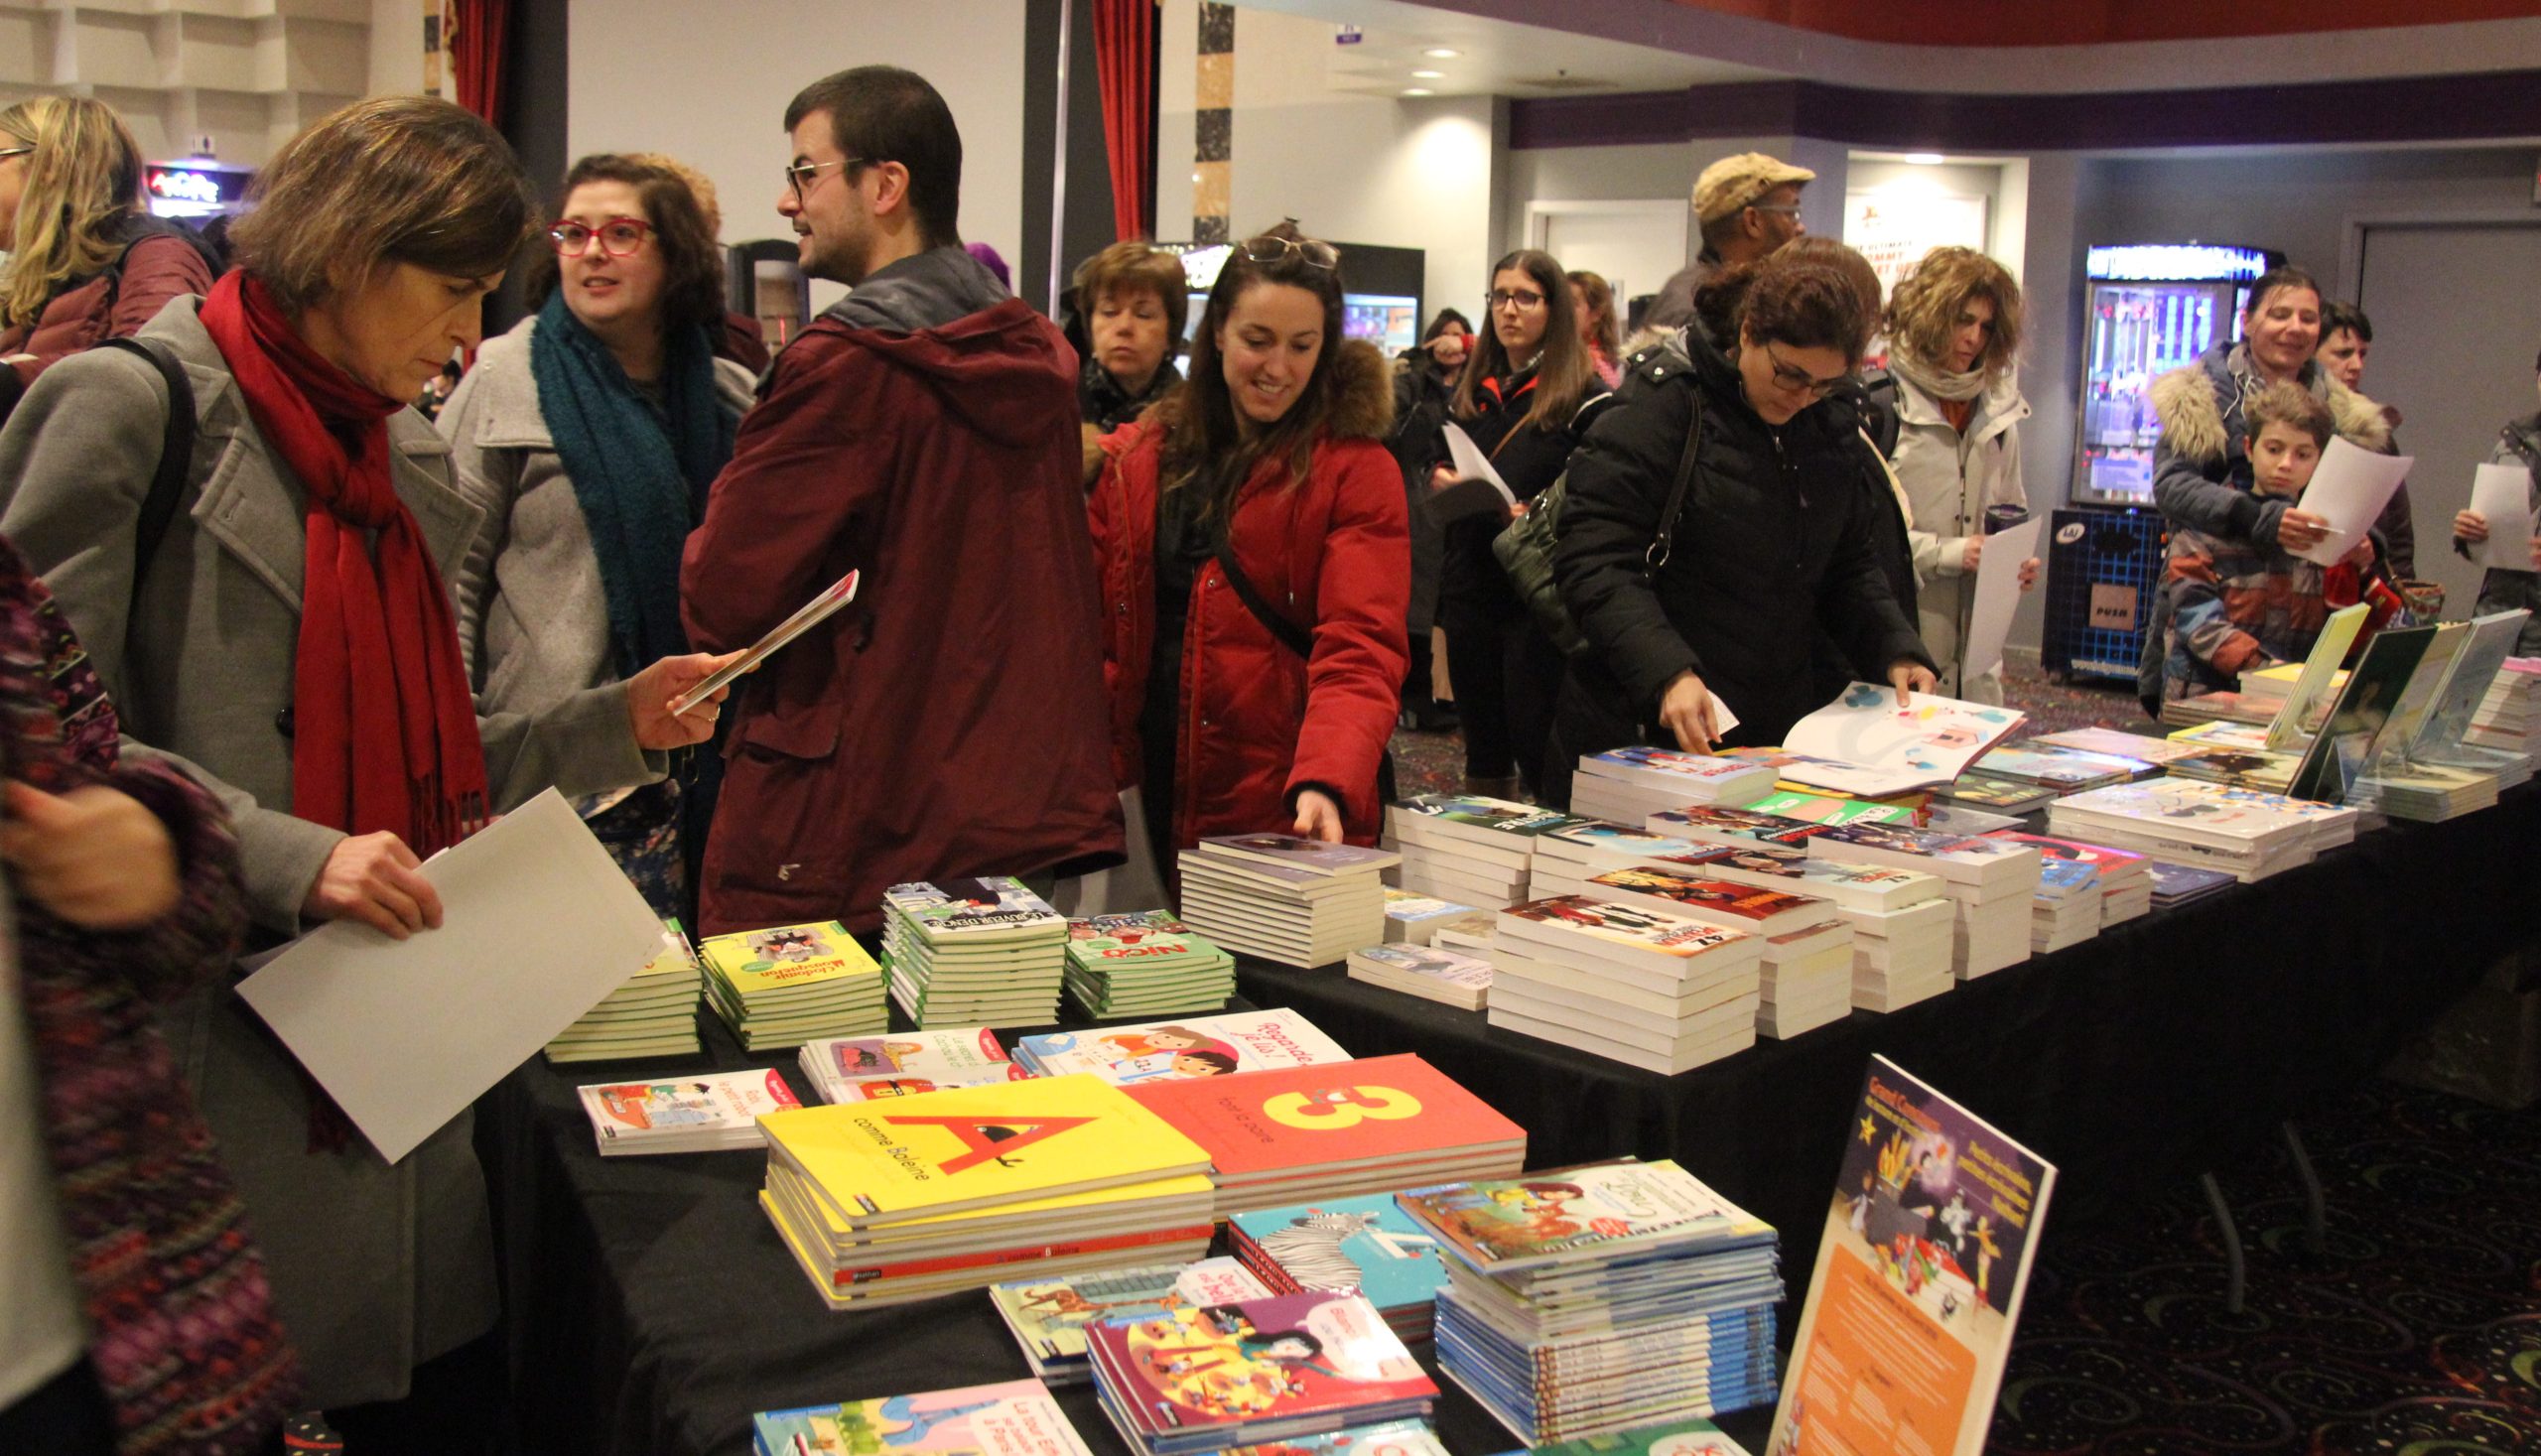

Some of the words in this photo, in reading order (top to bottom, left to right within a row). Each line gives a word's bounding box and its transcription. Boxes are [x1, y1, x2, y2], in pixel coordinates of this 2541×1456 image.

[1263, 1085, 1422, 1130] 3
[853, 1117, 893, 1149] comme
[886, 1146, 930, 1182] Baleine
[881, 1116, 1101, 1176] A
